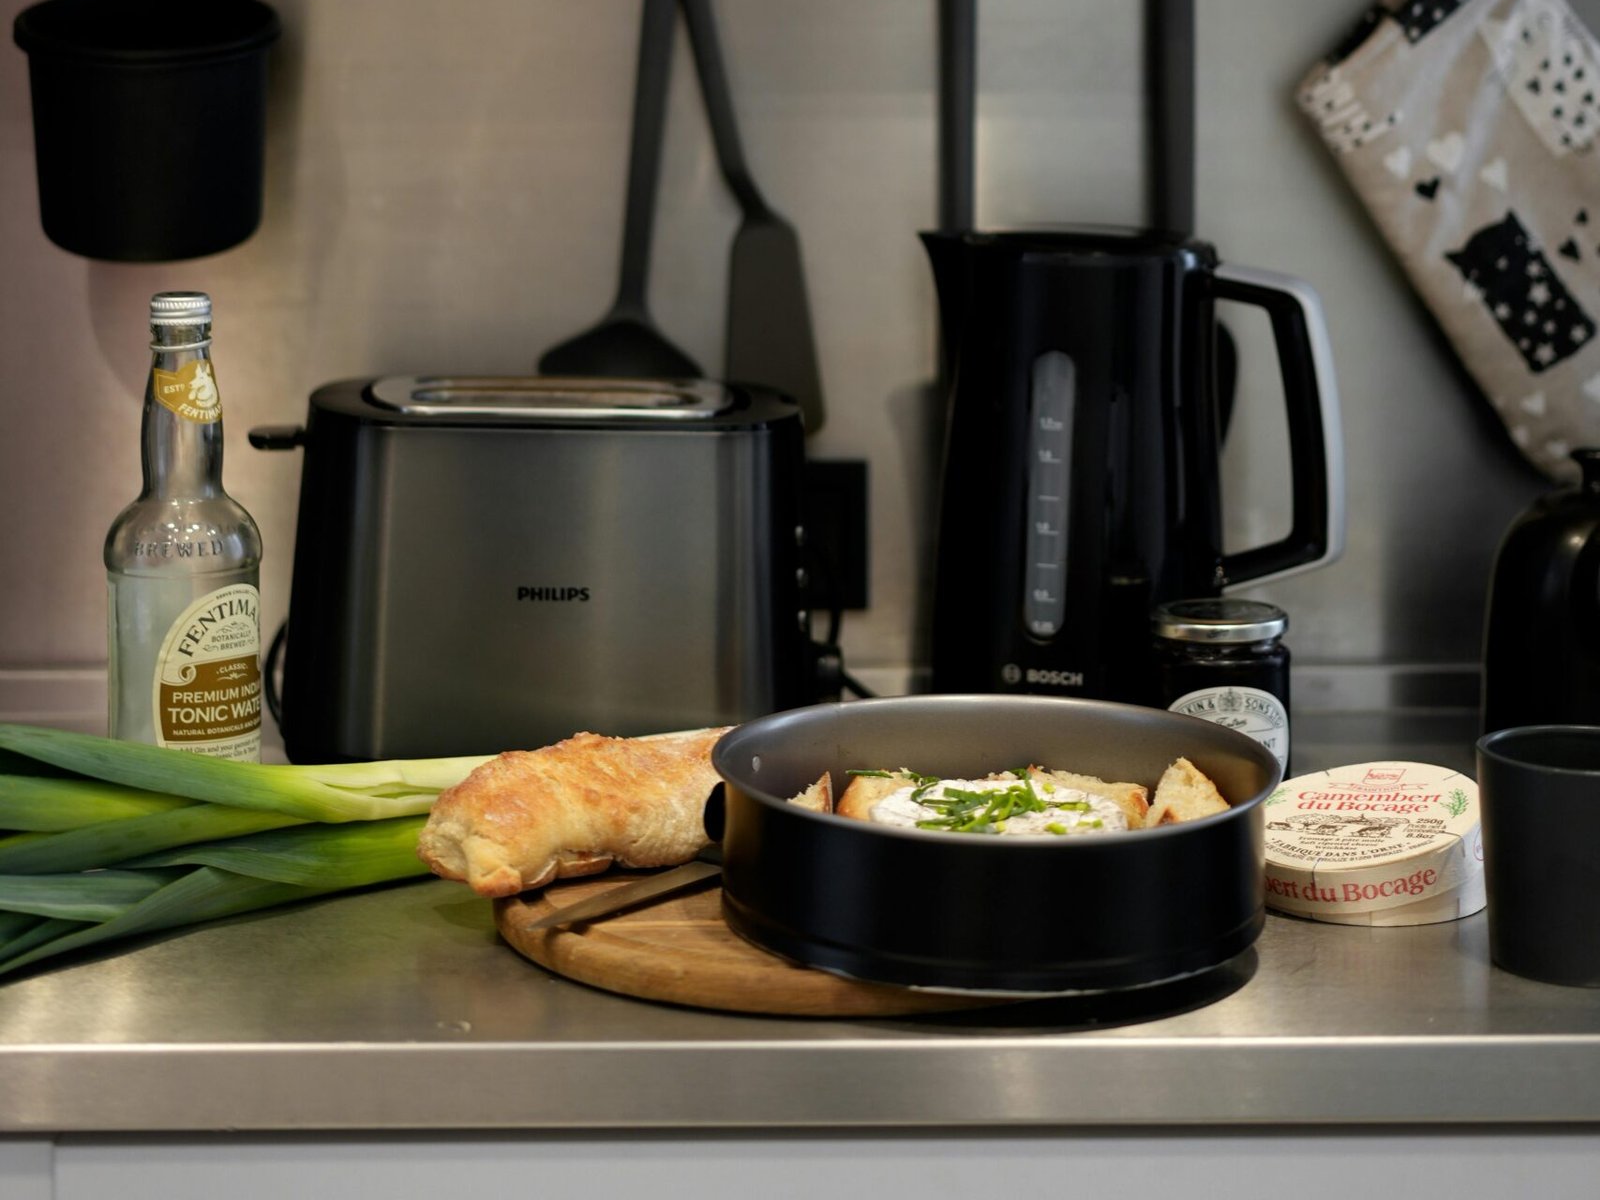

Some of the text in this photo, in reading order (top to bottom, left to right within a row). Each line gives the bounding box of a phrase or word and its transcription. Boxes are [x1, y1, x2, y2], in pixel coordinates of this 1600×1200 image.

[135, 540, 224, 559] BREWED
[518, 587, 590, 601] PHILIPS
[178, 599, 259, 657] FENTIMA
[1027, 669, 1084, 686] BOSCH
[173, 688, 239, 704] PREMIUM
[168, 705, 228, 724] TONIC
[1245, 698, 1271, 715] SONS
[173, 728, 205, 736] NATURAL
[1298, 790, 1442, 803] Camembert
[1297, 801, 1429, 814] du Bocage
[1360, 843, 1403, 856] L'ORNE
[1302, 882, 1337, 903] du
[1341, 868, 1437, 902] Bocage
